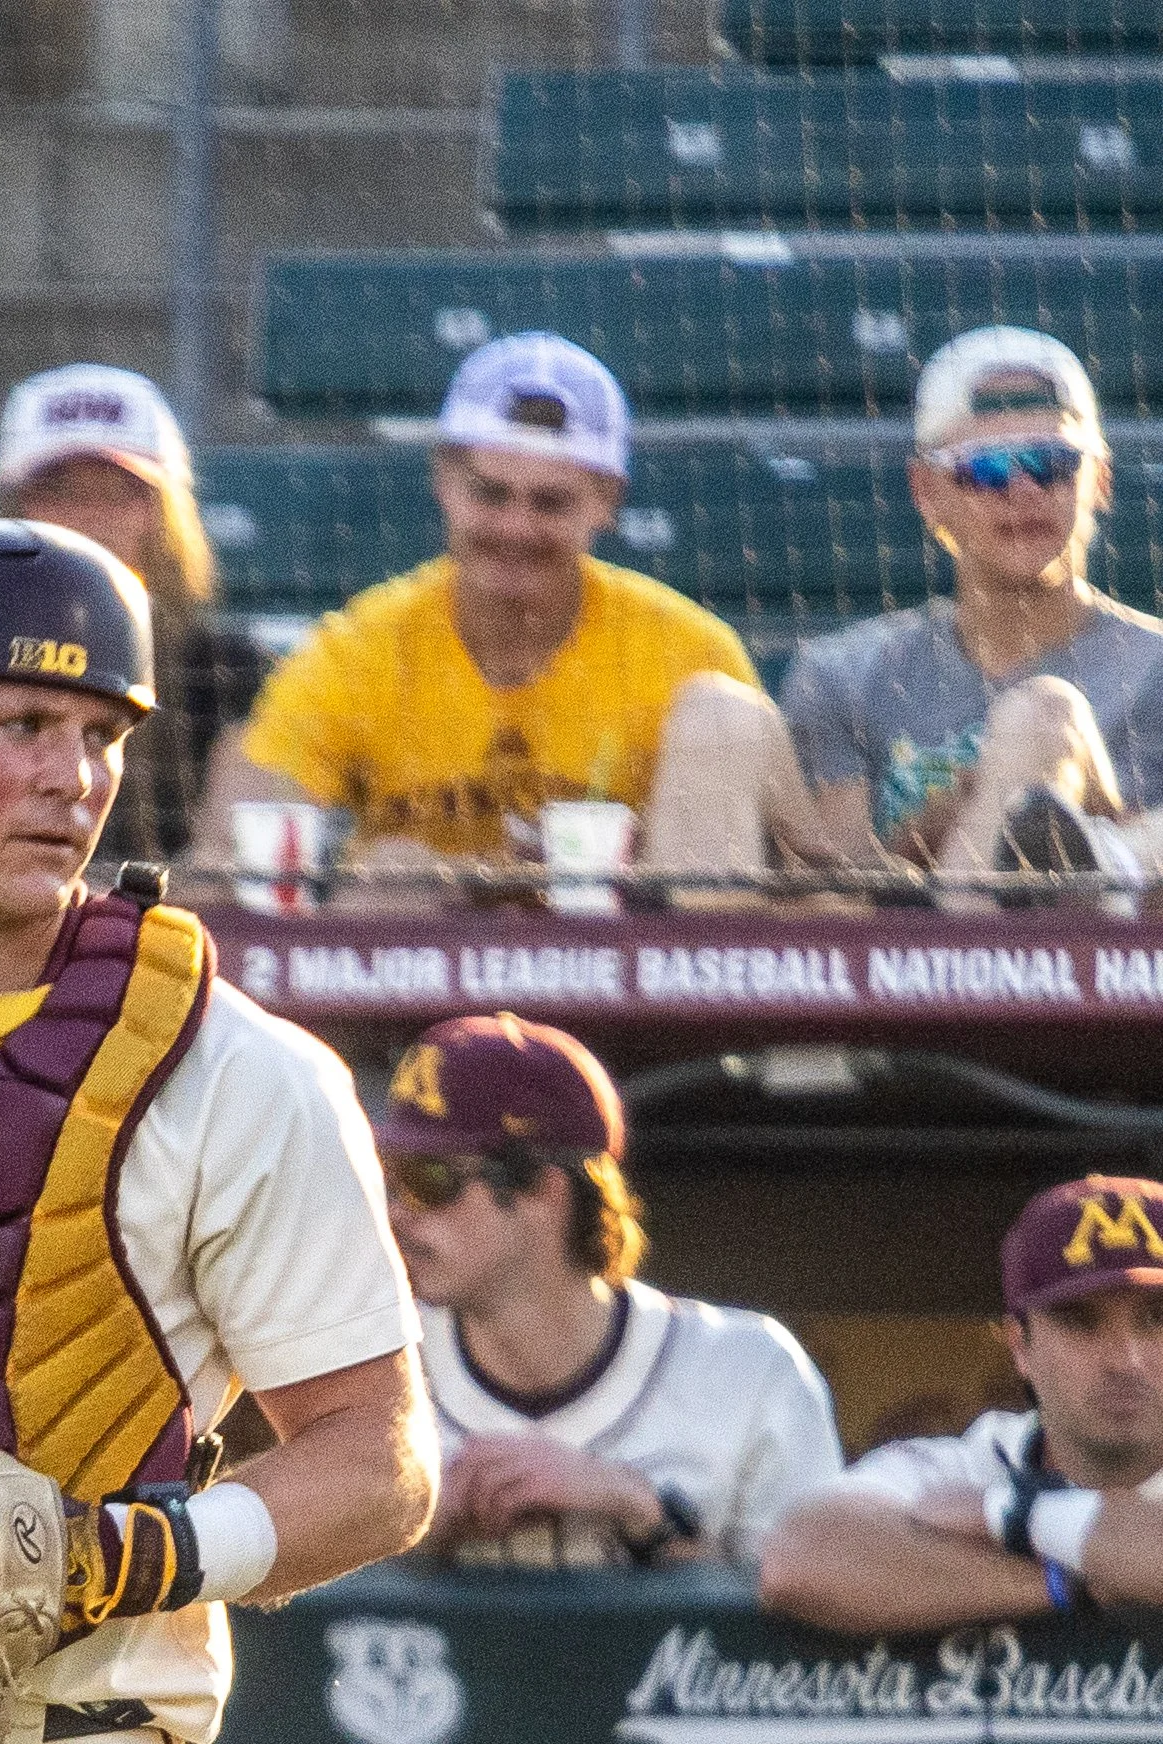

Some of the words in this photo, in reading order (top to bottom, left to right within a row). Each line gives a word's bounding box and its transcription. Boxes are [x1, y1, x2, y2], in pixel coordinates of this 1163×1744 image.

[240, 946, 279, 999] 2
[287, 947, 447, 1000] MAJOR
[459, 947, 626, 1001] LEAGUE
[638, 947, 857, 1001] BASEBALL
[868, 948, 1084, 1002] NATIONAL
[625, 1625, 924, 1714] Minnesota
